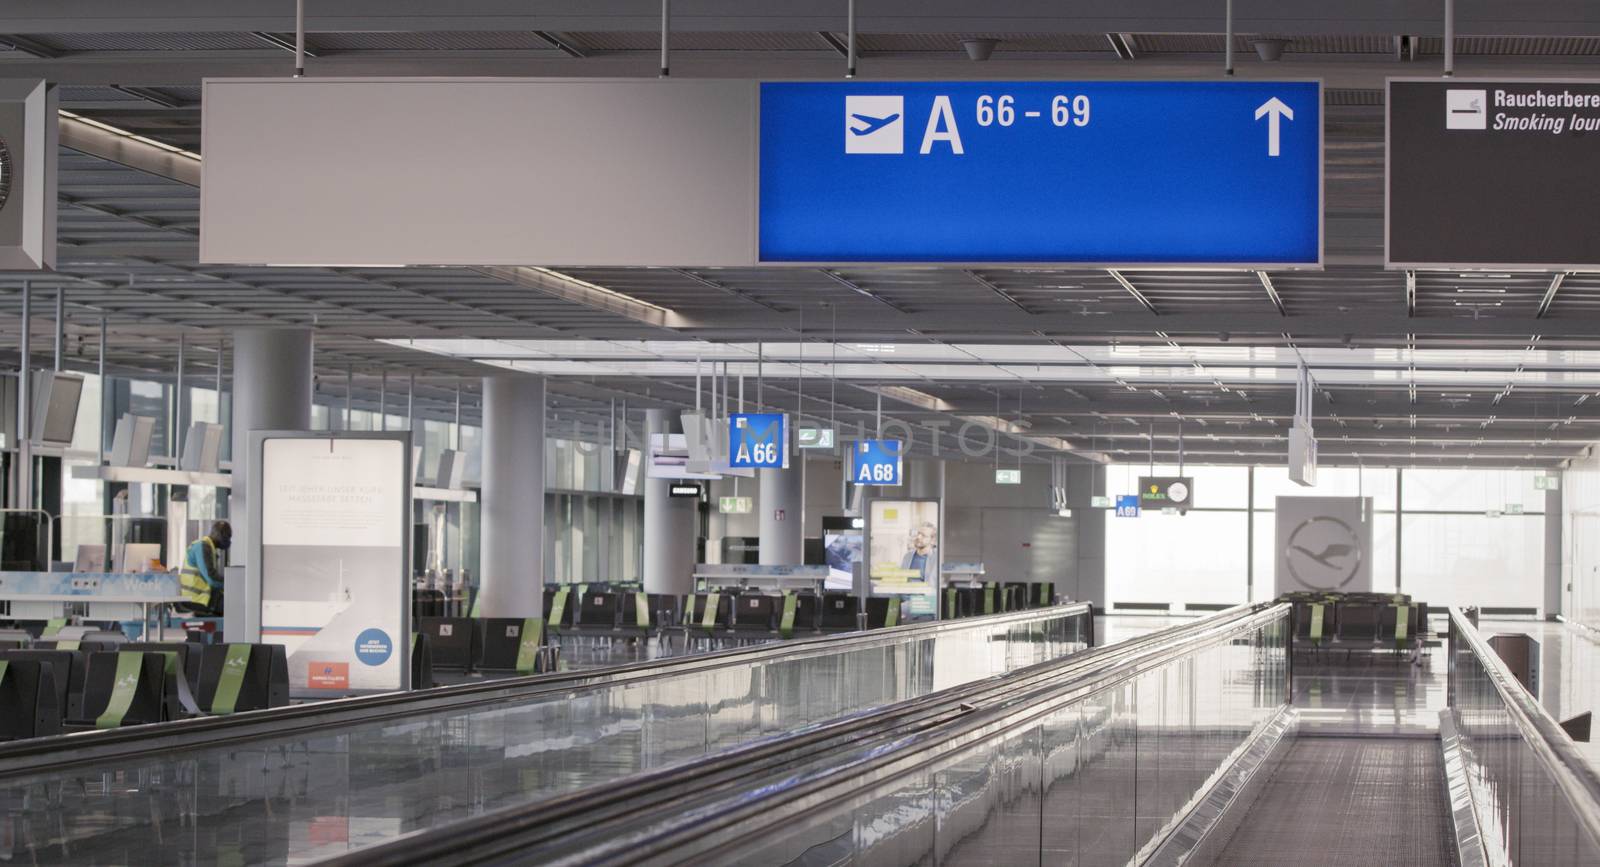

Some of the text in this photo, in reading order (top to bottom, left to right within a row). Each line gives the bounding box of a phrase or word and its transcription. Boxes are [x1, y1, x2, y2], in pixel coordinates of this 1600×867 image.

[919, 95, 965, 155] A
[976, 95, 1015, 127] 66
[1051, 95, 1090, 127] 69
[1493, 112, 1565, 135] Smoking
[125, 578, 162, 591] Work
